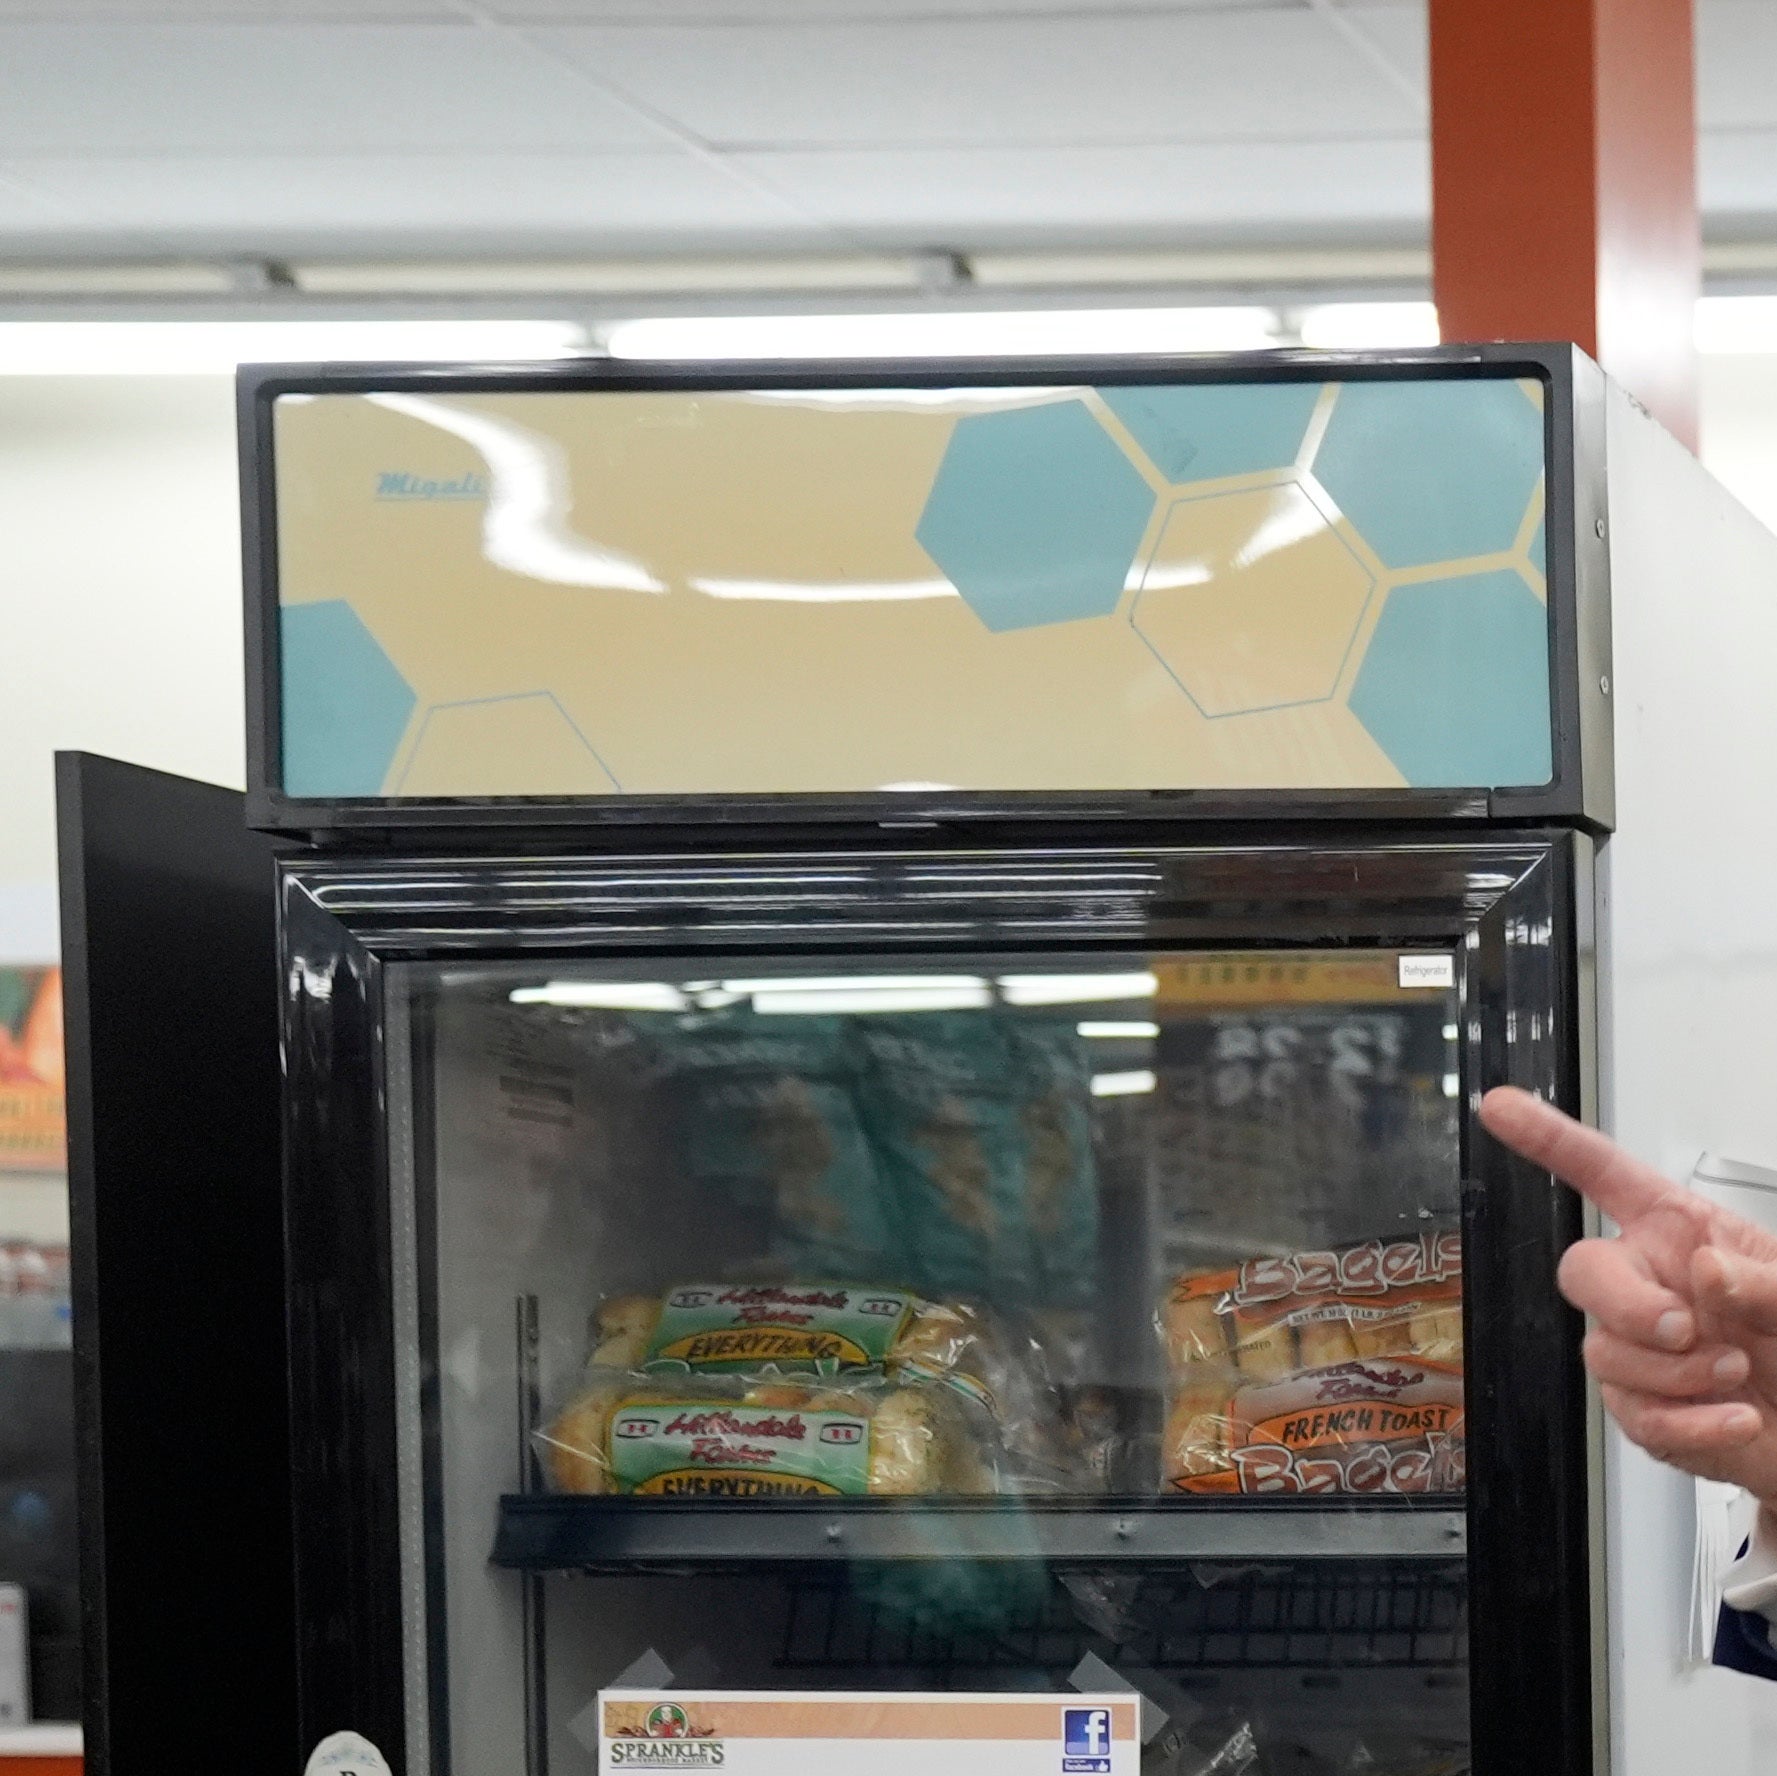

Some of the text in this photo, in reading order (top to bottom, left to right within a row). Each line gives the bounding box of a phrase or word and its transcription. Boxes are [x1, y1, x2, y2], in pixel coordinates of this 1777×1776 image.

[1404, 964, 1448, 978] Refrigerator
[1281, 1408, 1450, 1442] FRENCH TOAST
[611, 1742, 725, 1764] SPRANKLE'S
